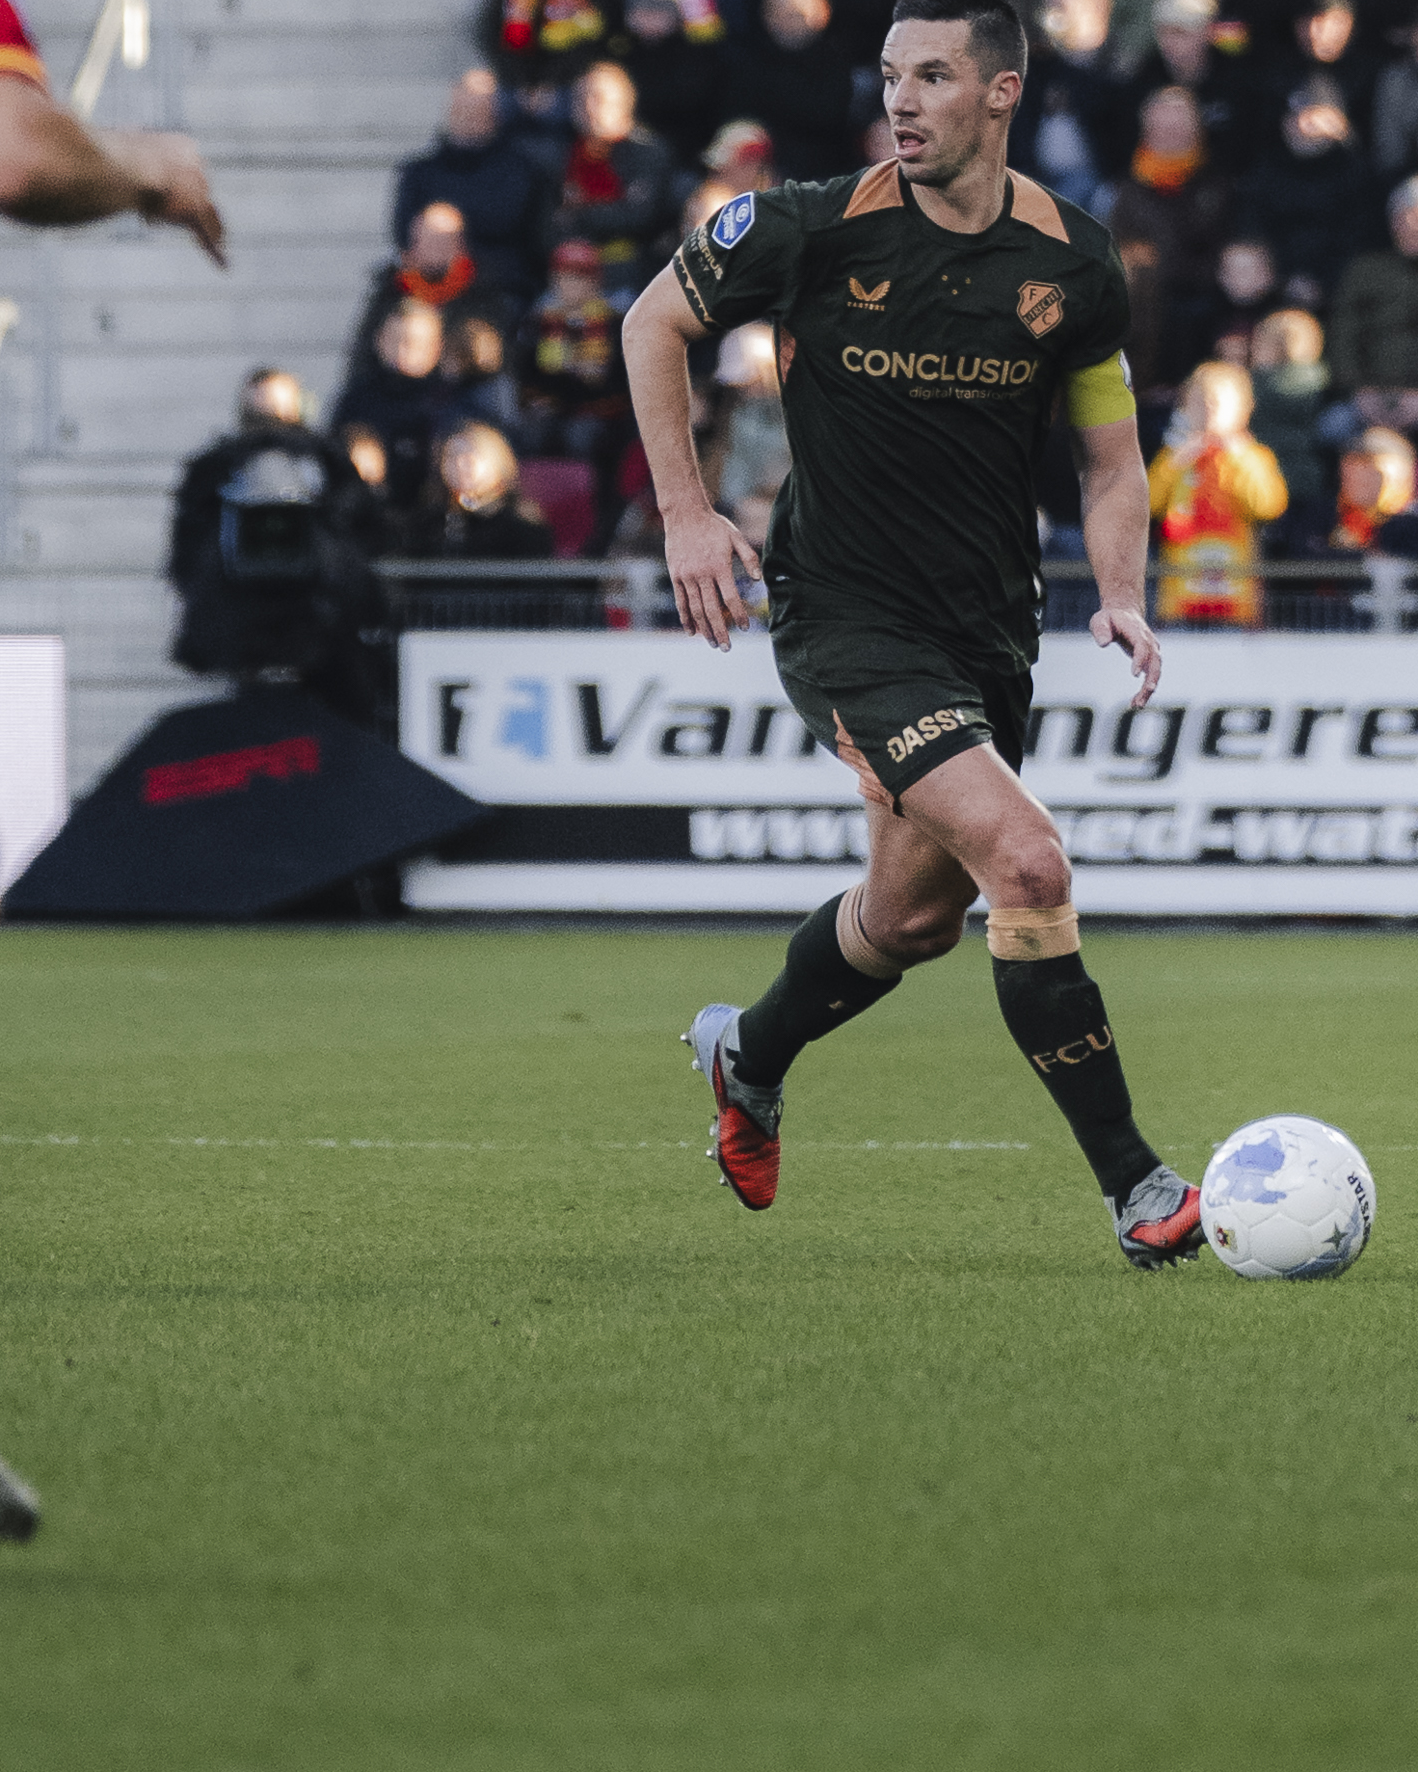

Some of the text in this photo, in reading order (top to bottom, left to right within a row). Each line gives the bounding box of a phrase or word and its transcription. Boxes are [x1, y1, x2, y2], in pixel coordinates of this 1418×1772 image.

[1028, 288, 1037, 301] F
[1041, 312, 1053, 325] C
[908, 386, 952, 399] digital
[1031, 1024, 1113, 1074] FCU
